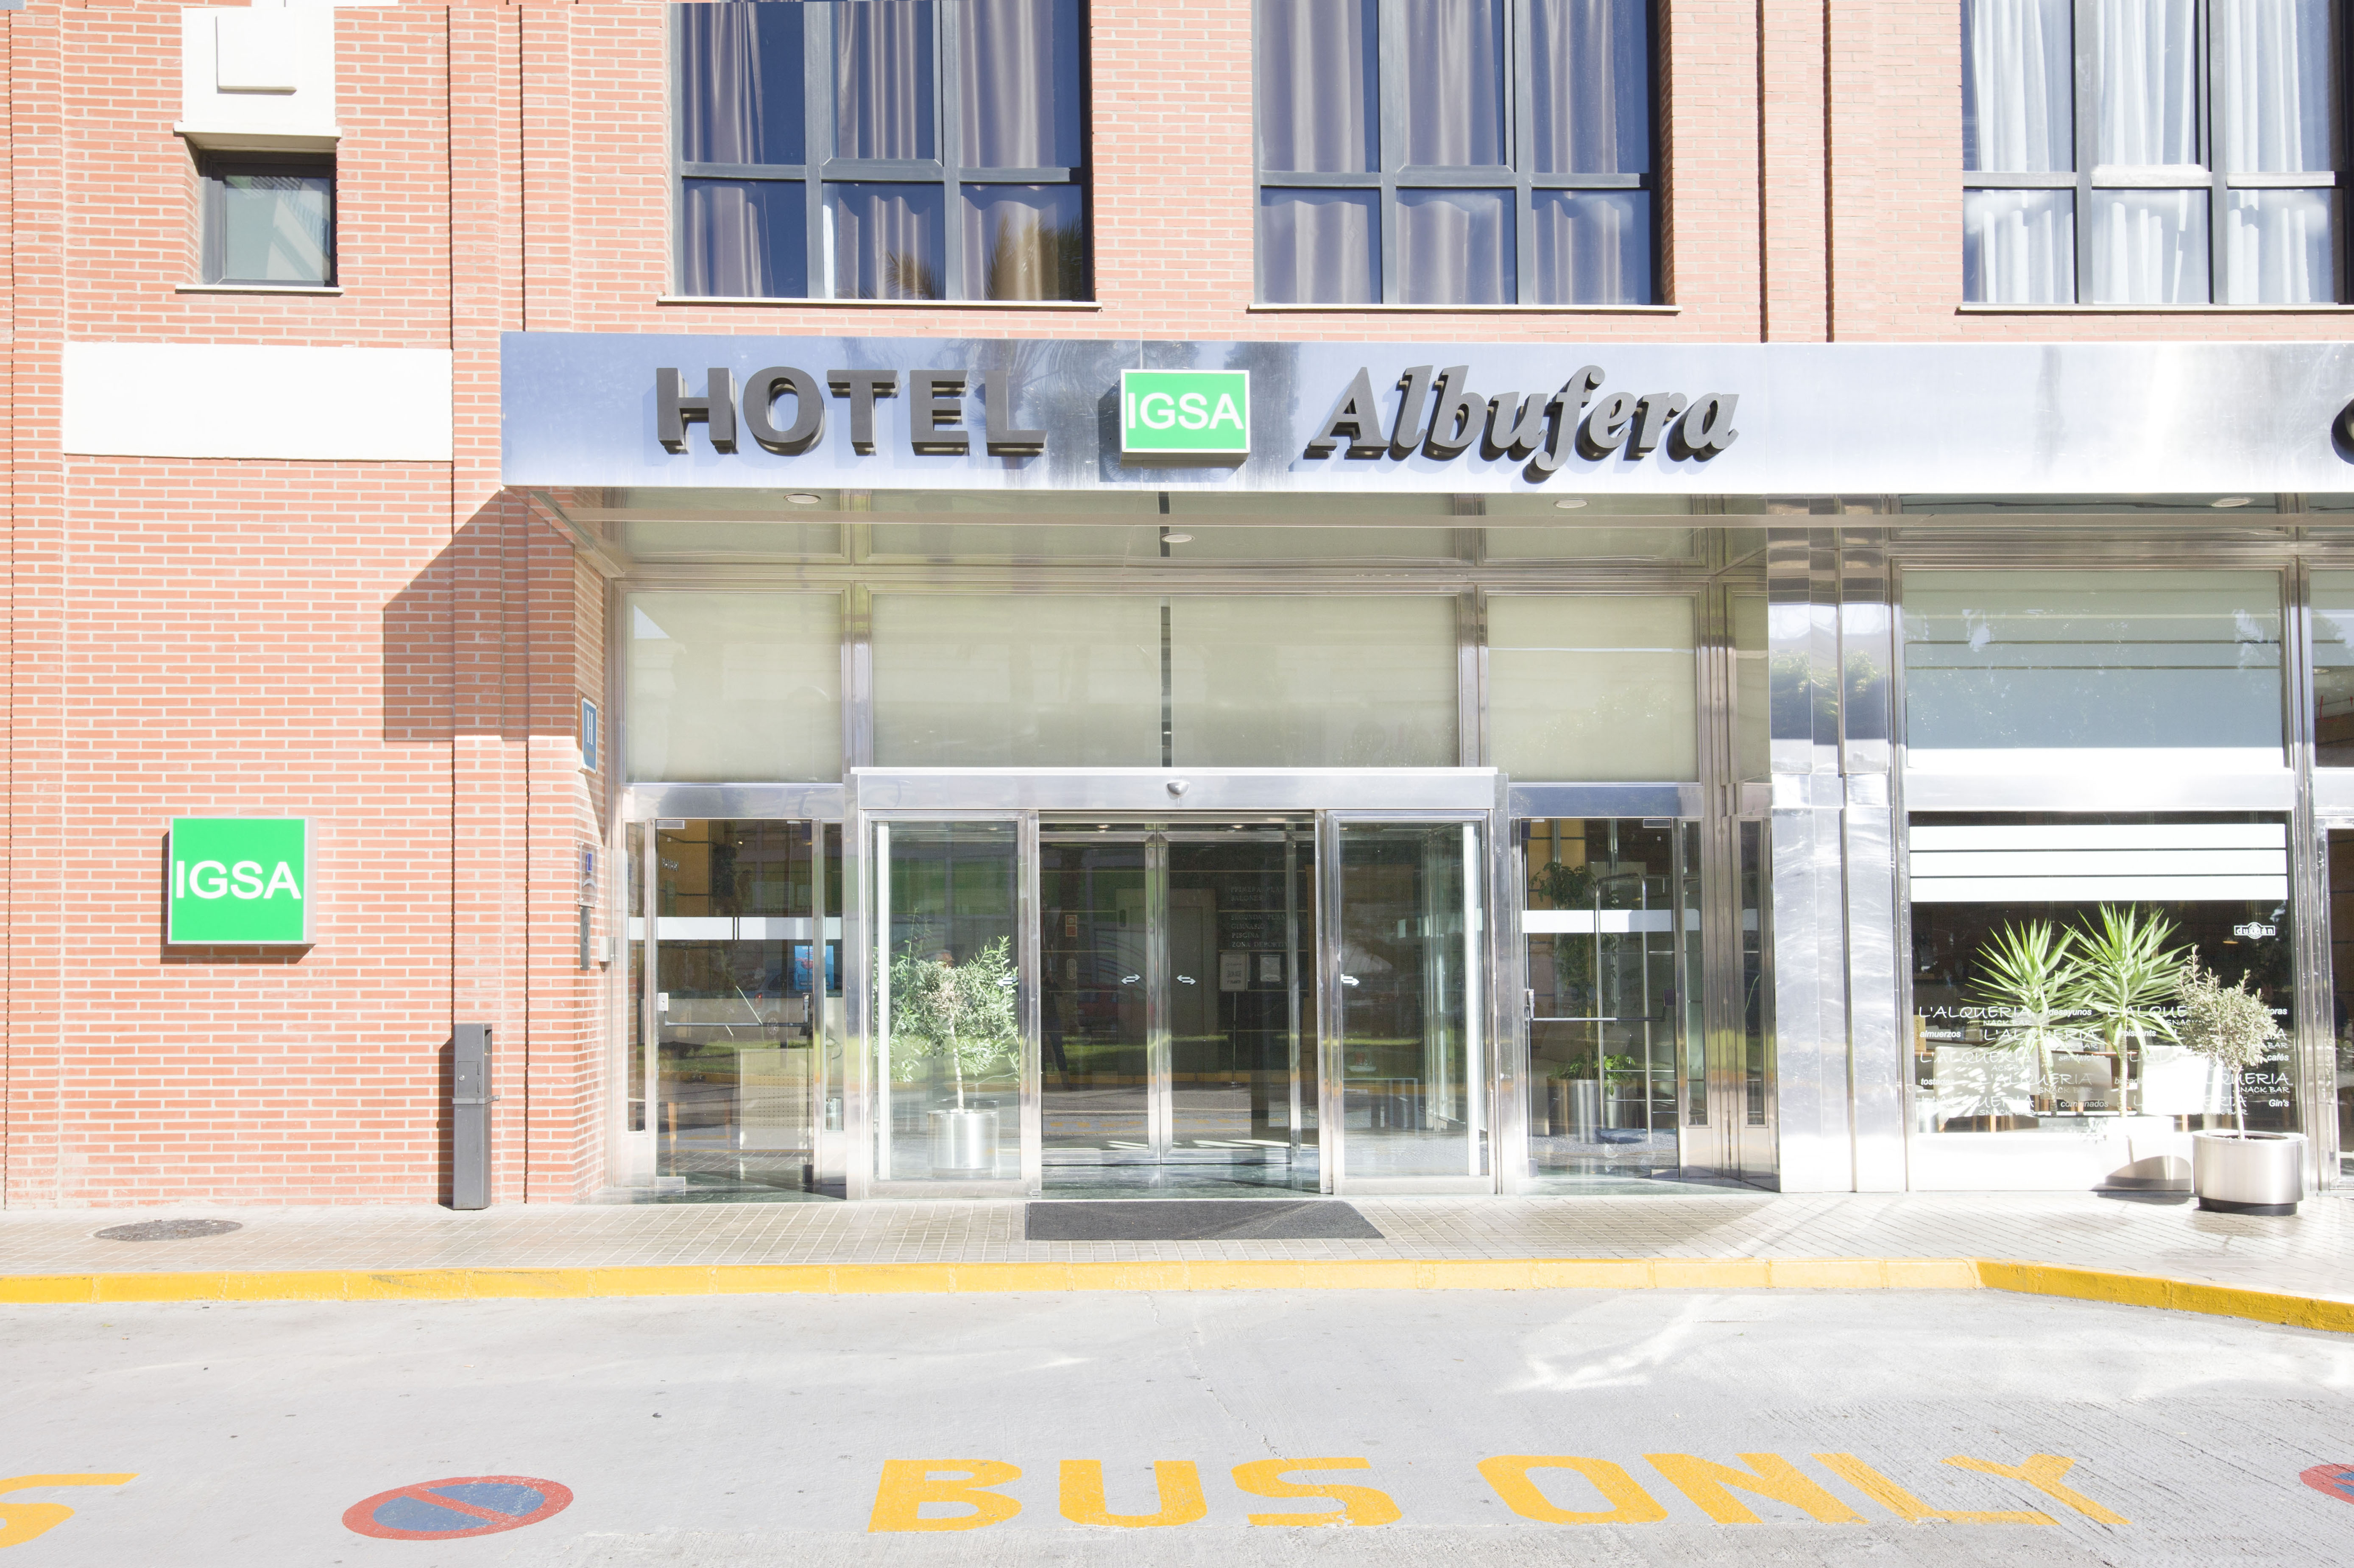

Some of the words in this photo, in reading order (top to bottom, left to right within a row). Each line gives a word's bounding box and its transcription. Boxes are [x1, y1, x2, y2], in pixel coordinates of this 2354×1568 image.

[656, 366, 1048, 456] HOTEL
[1127, 392, 1244, 430] IGSA
[1305, 365, 1739, 480] Albufera
[176, 860, 302, 899] IGSA
[1919, 1006, 2032, 1018] L'ALQUERIA
[2048, 1008, 2092, 1017] desayunos
[2268, 1099, 2289, 1107] Gin's
[867, 1457, 1403, 1533] BUS
[1475, 1453, 2132, 1526] ONLY
